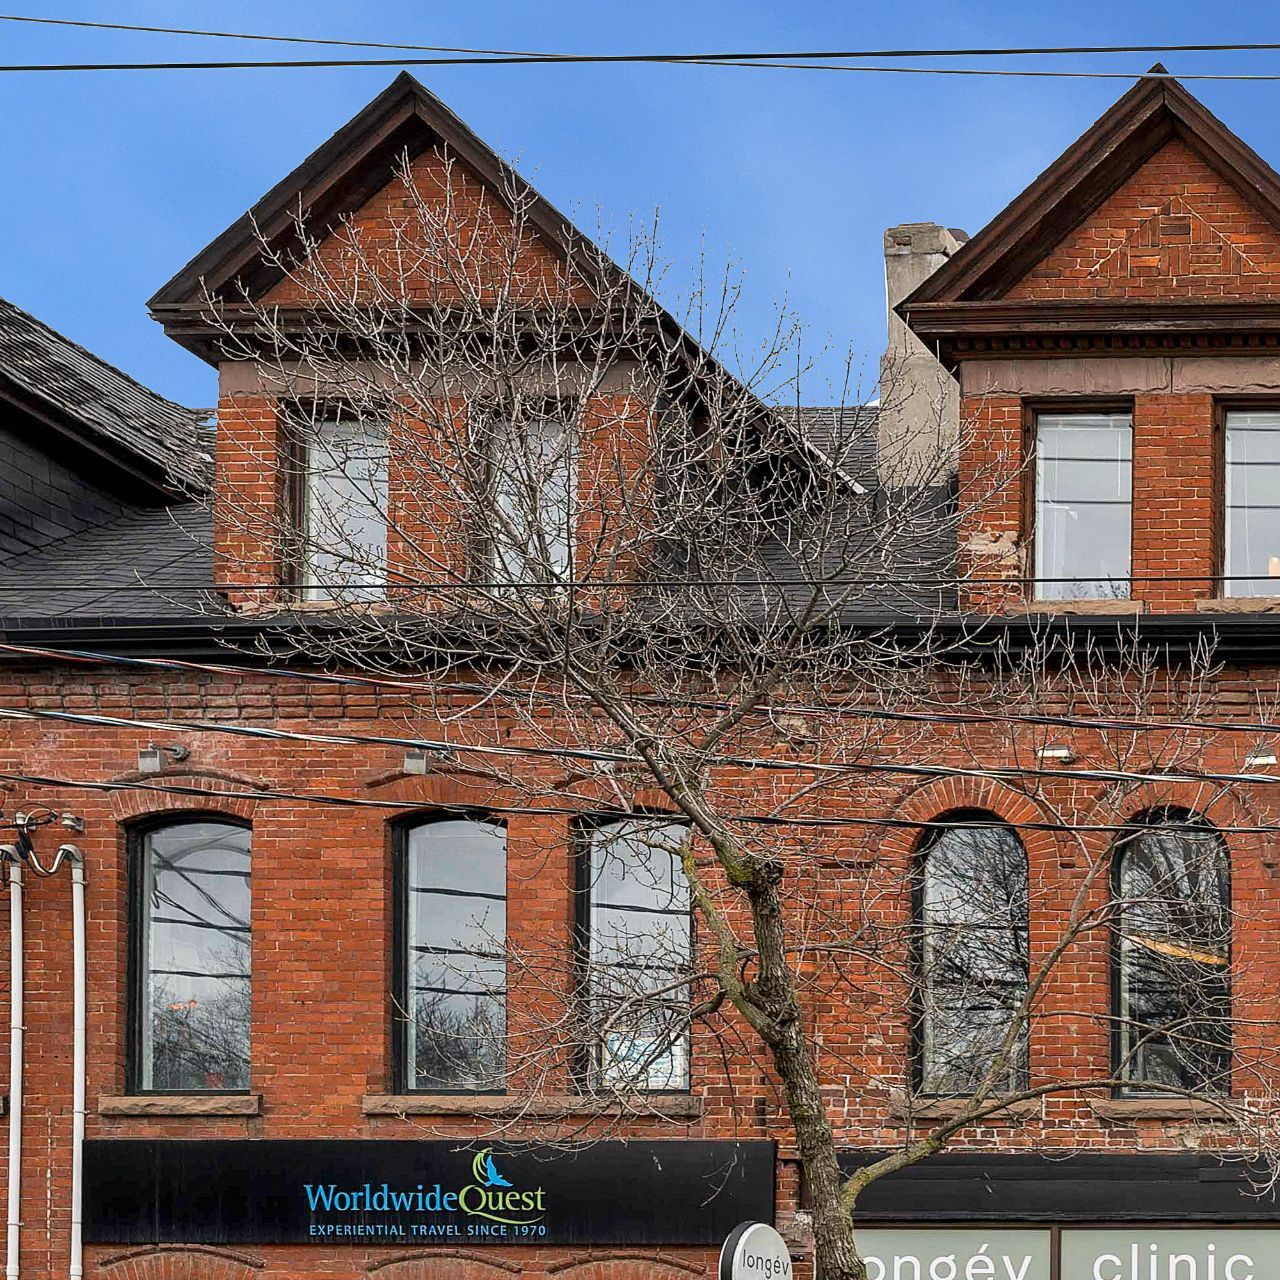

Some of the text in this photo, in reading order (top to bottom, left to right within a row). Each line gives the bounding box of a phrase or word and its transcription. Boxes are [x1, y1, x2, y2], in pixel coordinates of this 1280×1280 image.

[303, 1184, 547, 1225] WorldwideQuest
[309, 1224, 547, 1236] EXPERIENTIAL TRAVEL SINCE 1970
[741, 1248, 790, 1279] longév
